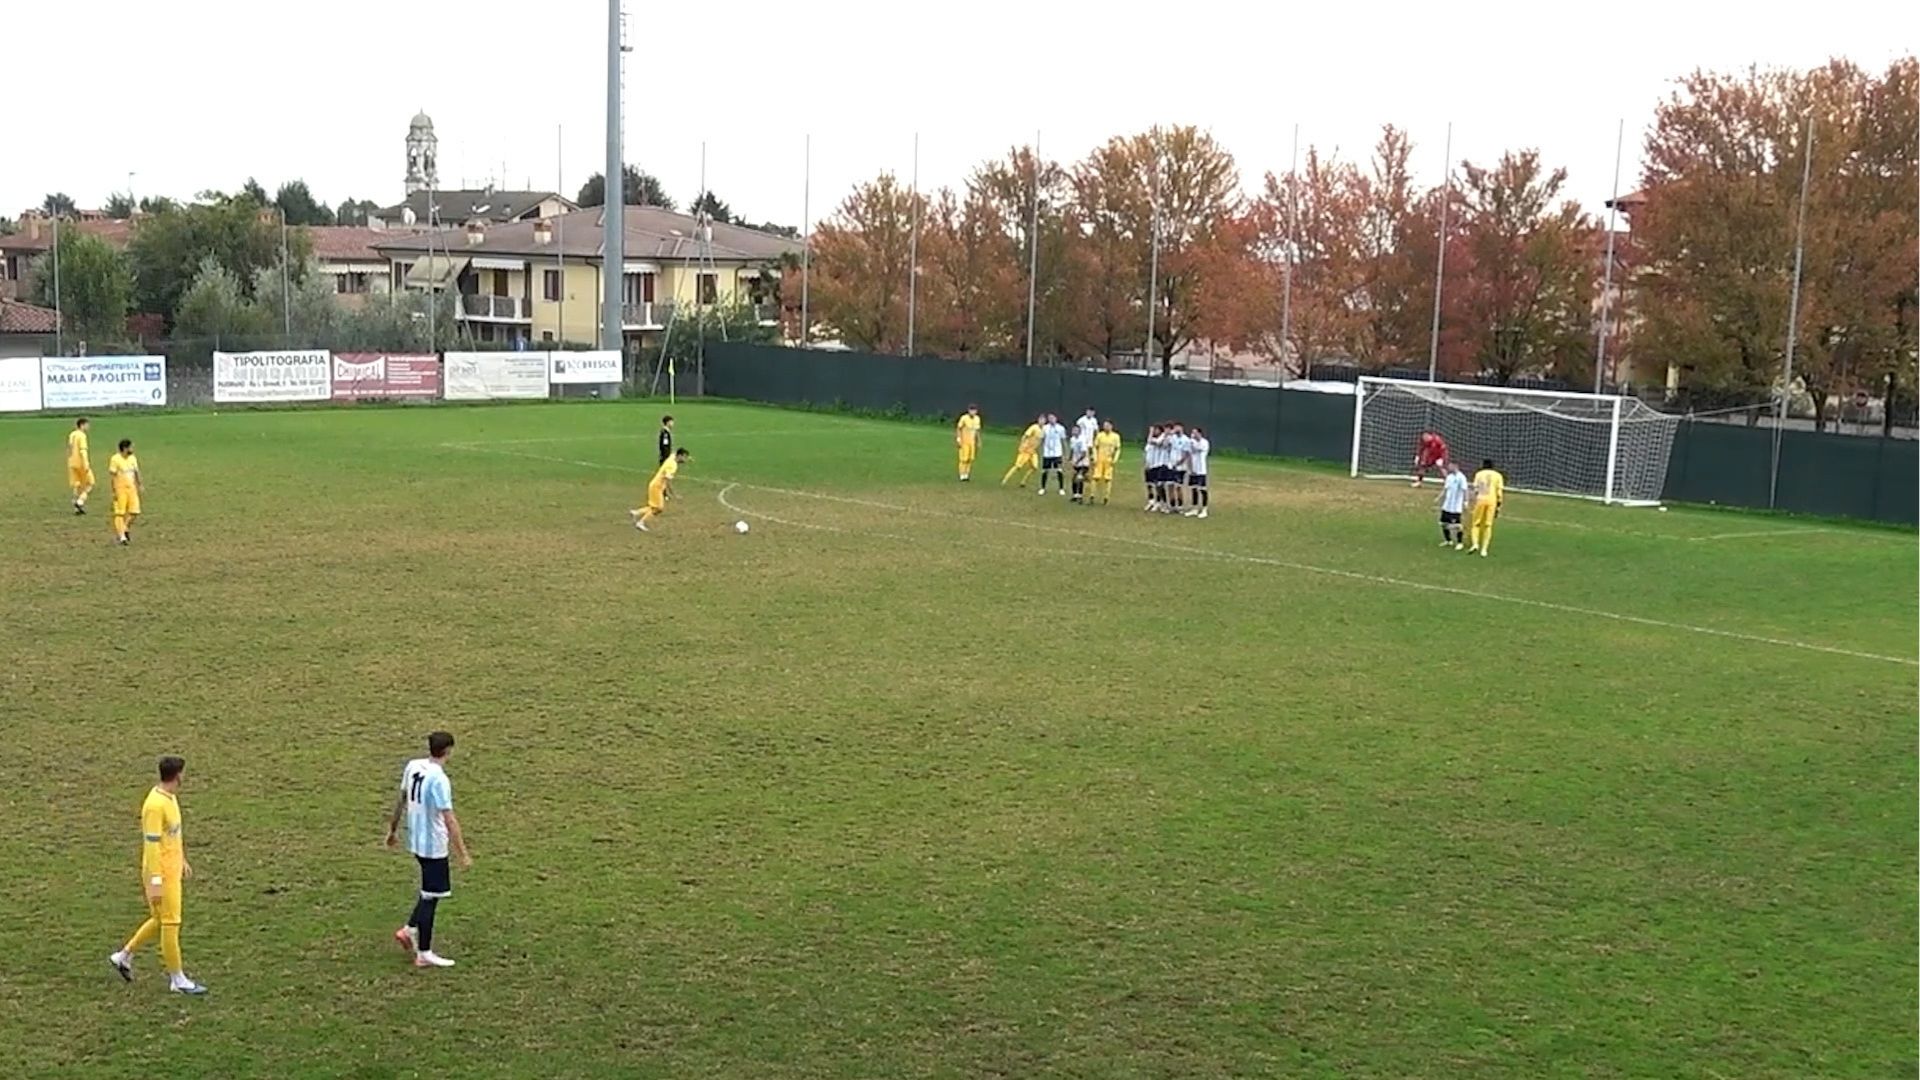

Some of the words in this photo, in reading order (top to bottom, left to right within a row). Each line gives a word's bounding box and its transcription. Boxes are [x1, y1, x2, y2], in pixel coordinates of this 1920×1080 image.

[233, 355, 327, 367] TIPOLITOGRAFIA
[47, 374, 87, 384] MARIA
[91, 372, 141, 383] PAOLETTI
[412, 771, 425, 804] 11
